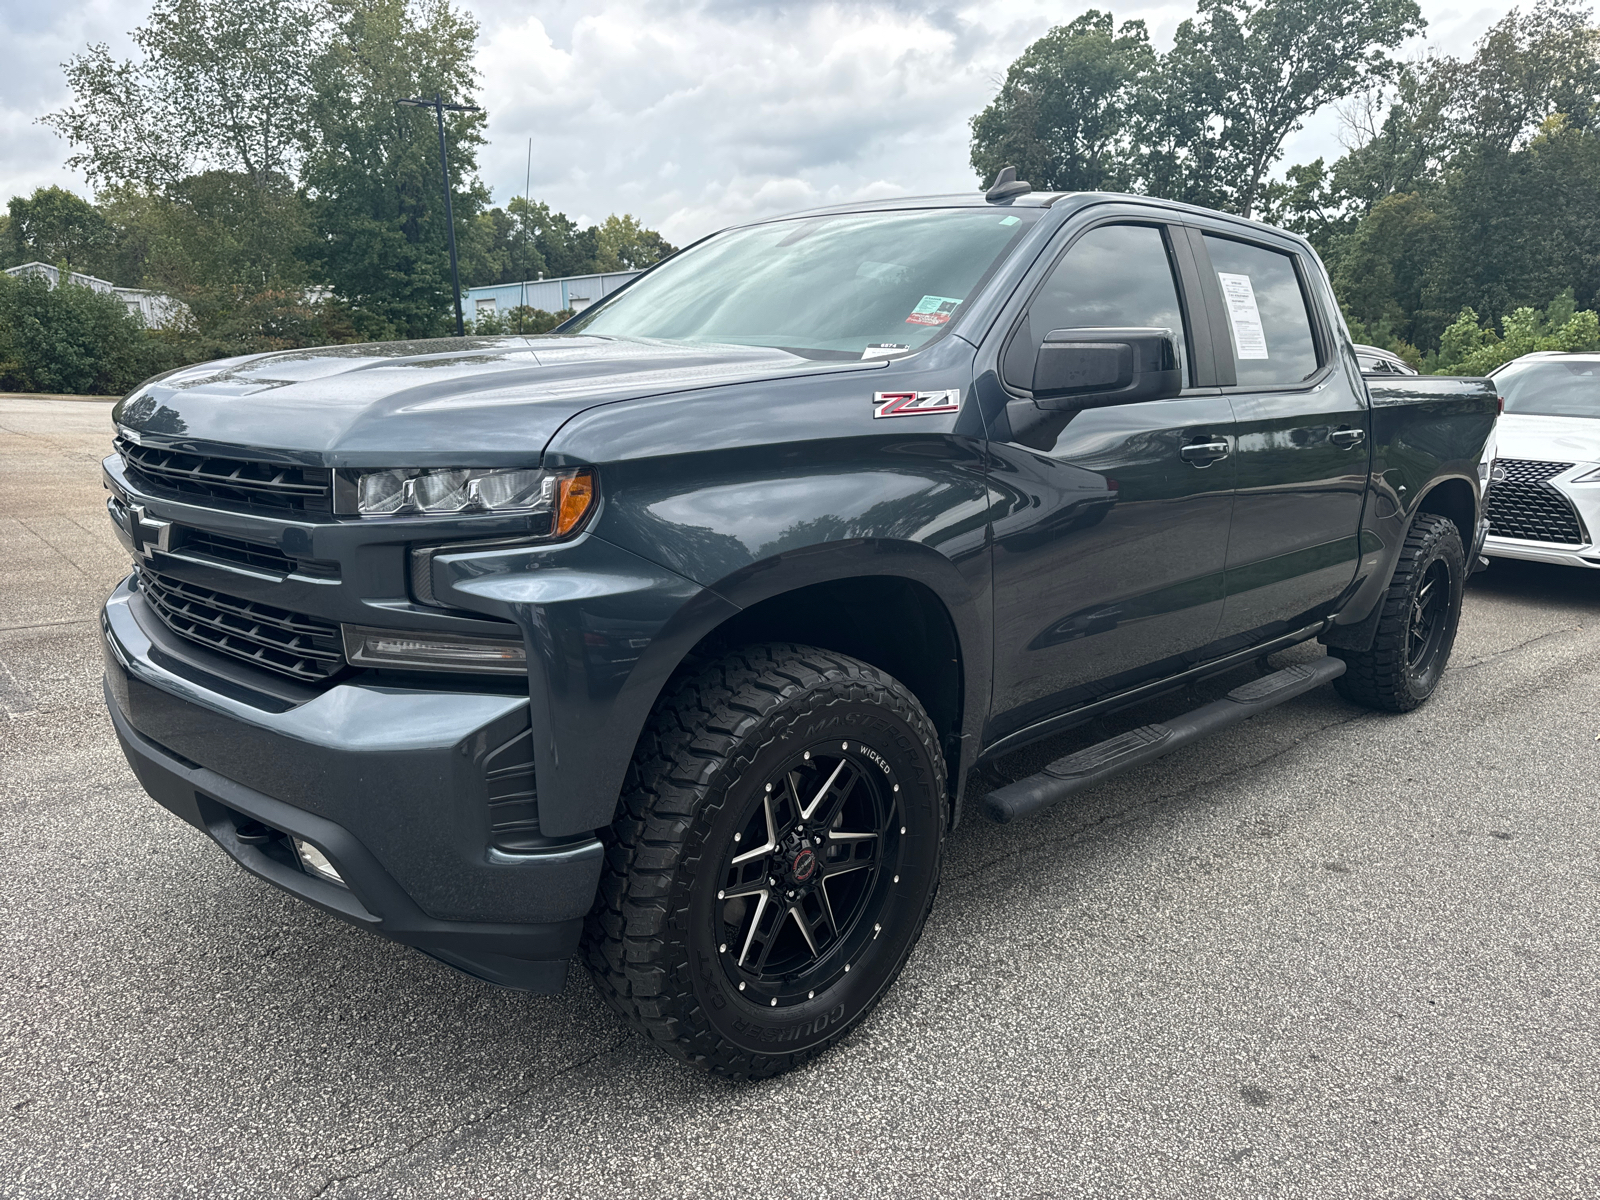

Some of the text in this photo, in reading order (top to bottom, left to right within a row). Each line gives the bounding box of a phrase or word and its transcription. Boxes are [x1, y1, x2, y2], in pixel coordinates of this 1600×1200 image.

[873, 389, 960, 419] Z71
[801, 711, 932, 811] MASTERCRAFT
[860, 745, 891, 775] WICKED
[696, 950, 845, 1042] COURSER CXT
